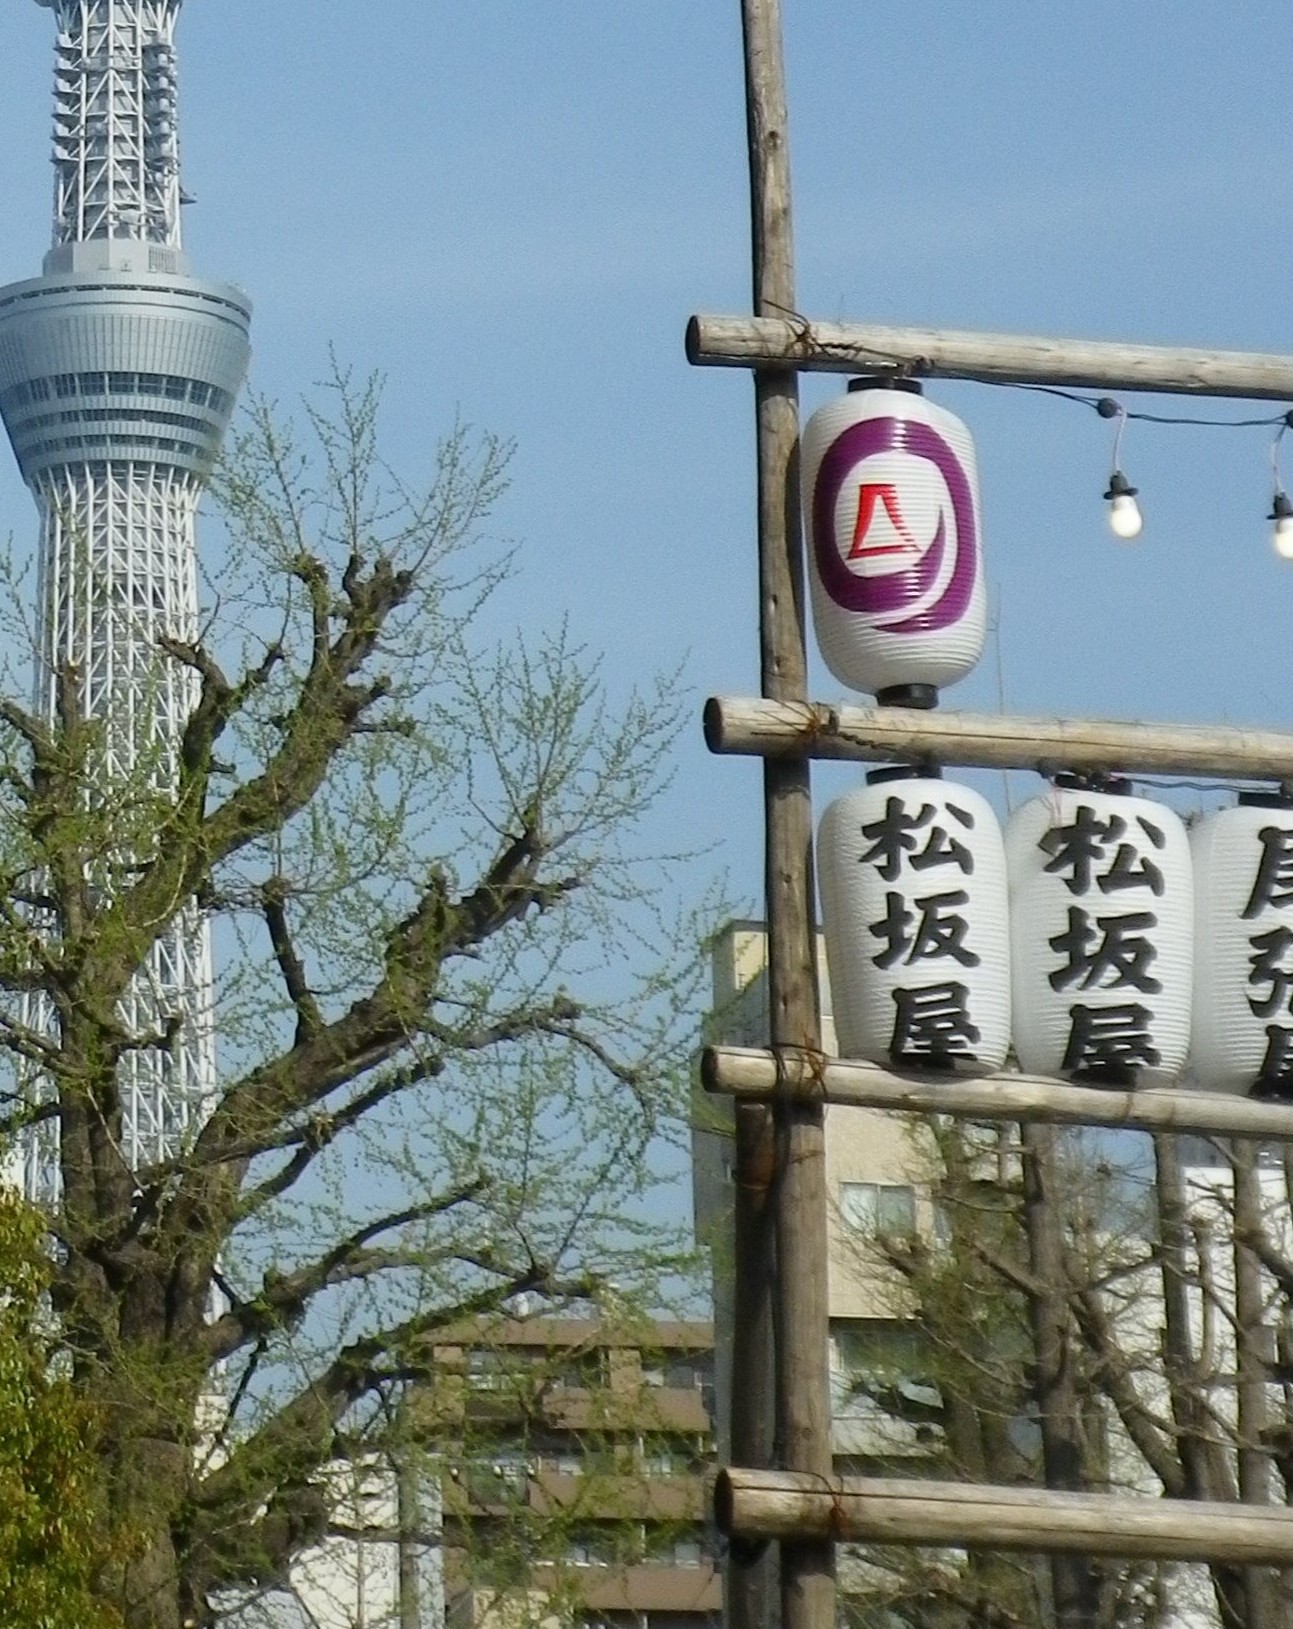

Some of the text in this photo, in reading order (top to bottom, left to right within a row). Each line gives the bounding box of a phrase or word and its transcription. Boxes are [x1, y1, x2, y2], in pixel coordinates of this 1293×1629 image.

[858, 796, 981, 1071] 松坂屋
[1037, 805, 1164, 1091] 松坂屋
